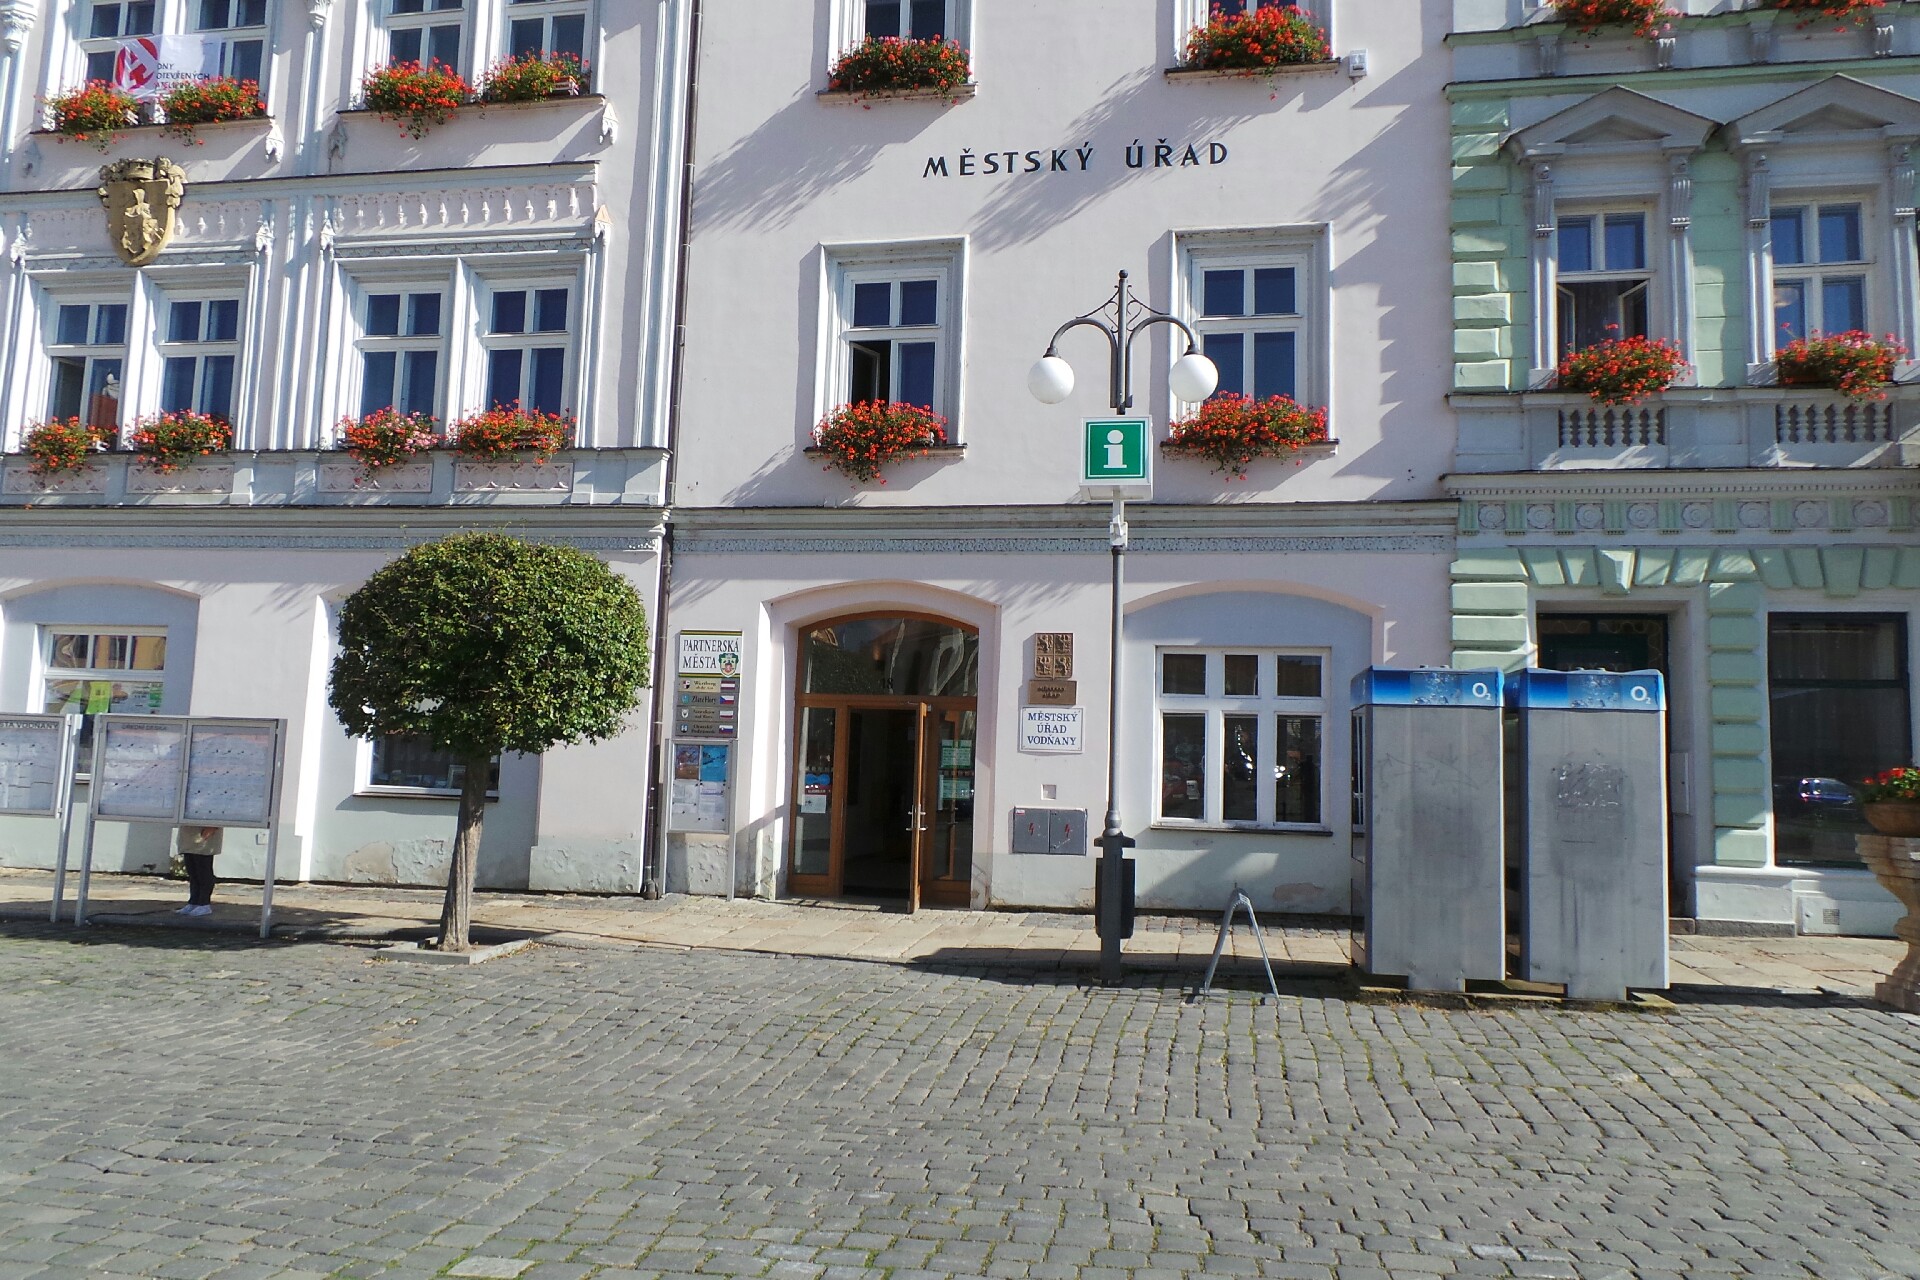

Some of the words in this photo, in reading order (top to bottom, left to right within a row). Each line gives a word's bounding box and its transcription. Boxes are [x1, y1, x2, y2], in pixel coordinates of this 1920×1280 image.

[157, 62, 174, 70] DNY
[156, 70, 210, 80] OTEVŘENÝCH
[922, 141, 1094, 178] MĚSTSKÝ
[1125, 138, 1228, 168] ÚŘAD
[683, 638, 739, 653] PARTNERSKÁ
[683, 653, 717, 669] MĚSTA
[1028, 711, 1078, 722] MĚSTSKÝ
[1037, 722, 1067, 734] ÚŘAD
[1027, 734, 1077, 746] VODŇANY
